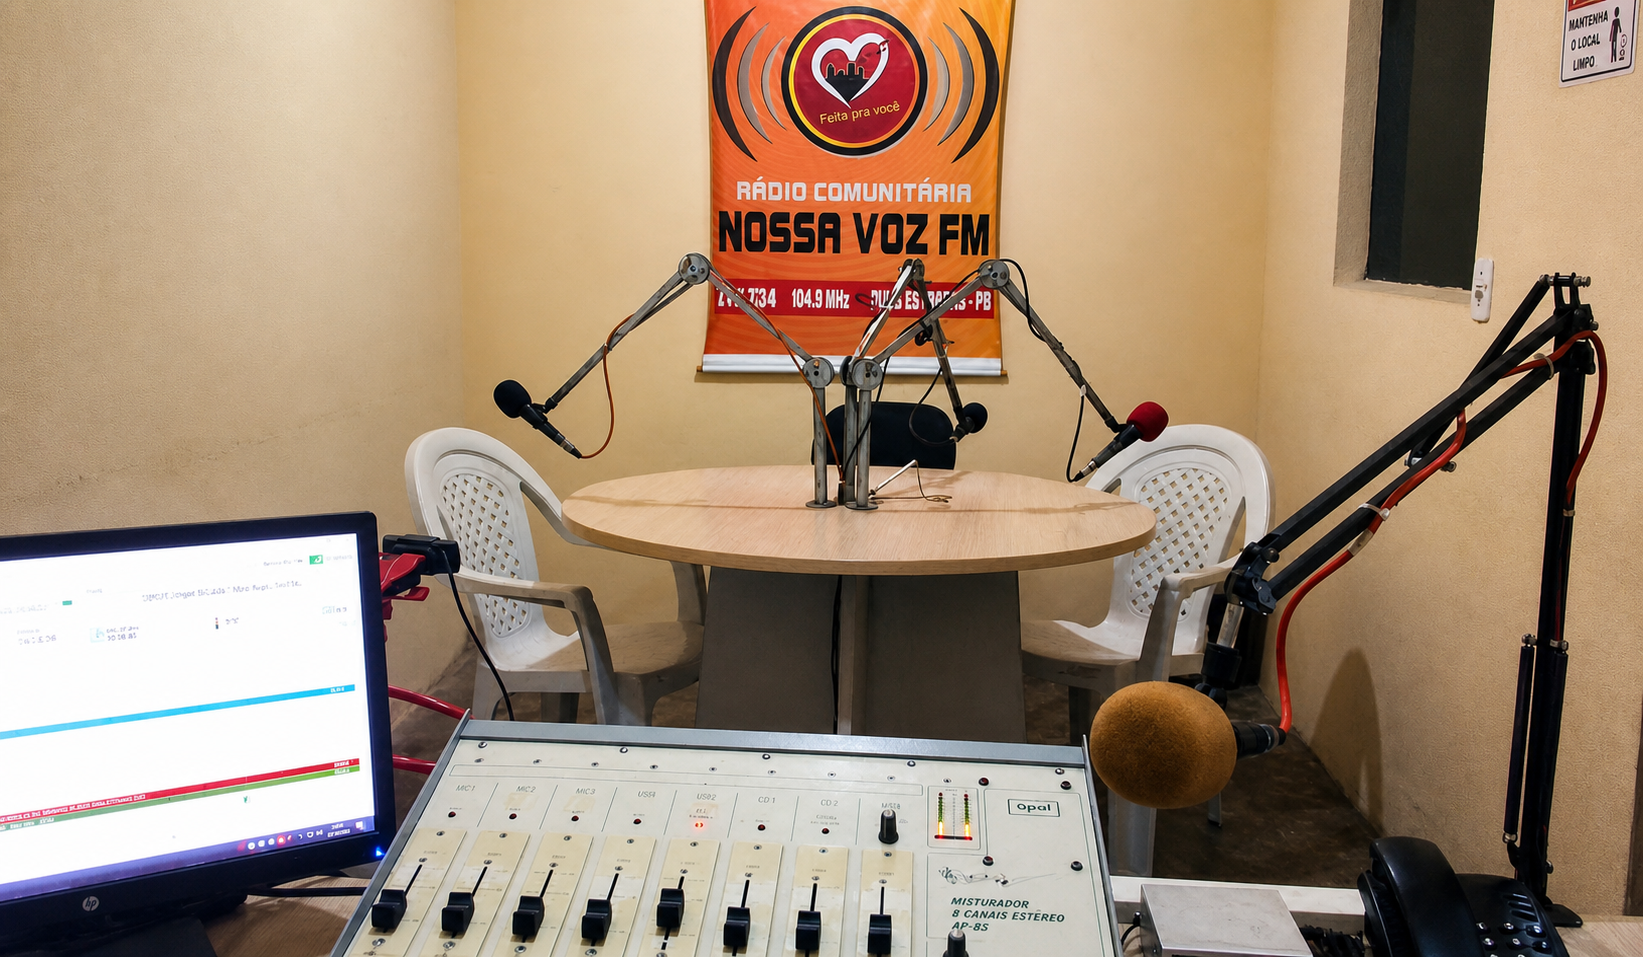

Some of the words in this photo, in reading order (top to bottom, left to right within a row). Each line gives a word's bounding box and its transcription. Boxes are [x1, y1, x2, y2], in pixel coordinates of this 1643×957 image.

[1569, 10, 1608, 31] MANTENHA
[1571, 39, 1576, 51] O
[1578, 33, 1600, 49] LOCAL
[1573, 55, 1595, 71] LIMPO
[819, 112, 848, 124] Feita
[851, 108, 870, 121] pra
[873, 101, 900, 115] você
[737, 176, 806, 201] RÁDIO
[814, 177, 972, 203] COMUNITÁRIA
[718, 211, 841, 254] NOSSA
[853, 213, 928, 255] VOZ
[939, 214, 990, 256] FM
[791, 288, 823, 308] 104.9
[825, 289, 850, 309] MHz
[975, 291, 992, 310] PB
[1017, 803, 1051, 813] Opal
[951, 897, 1029, 909] MISTURADOR
[952, 909, 960, 918] 8
[963, 909, 1008, 920] CANAIS
[951, 921, 989, 932] AP-8S
